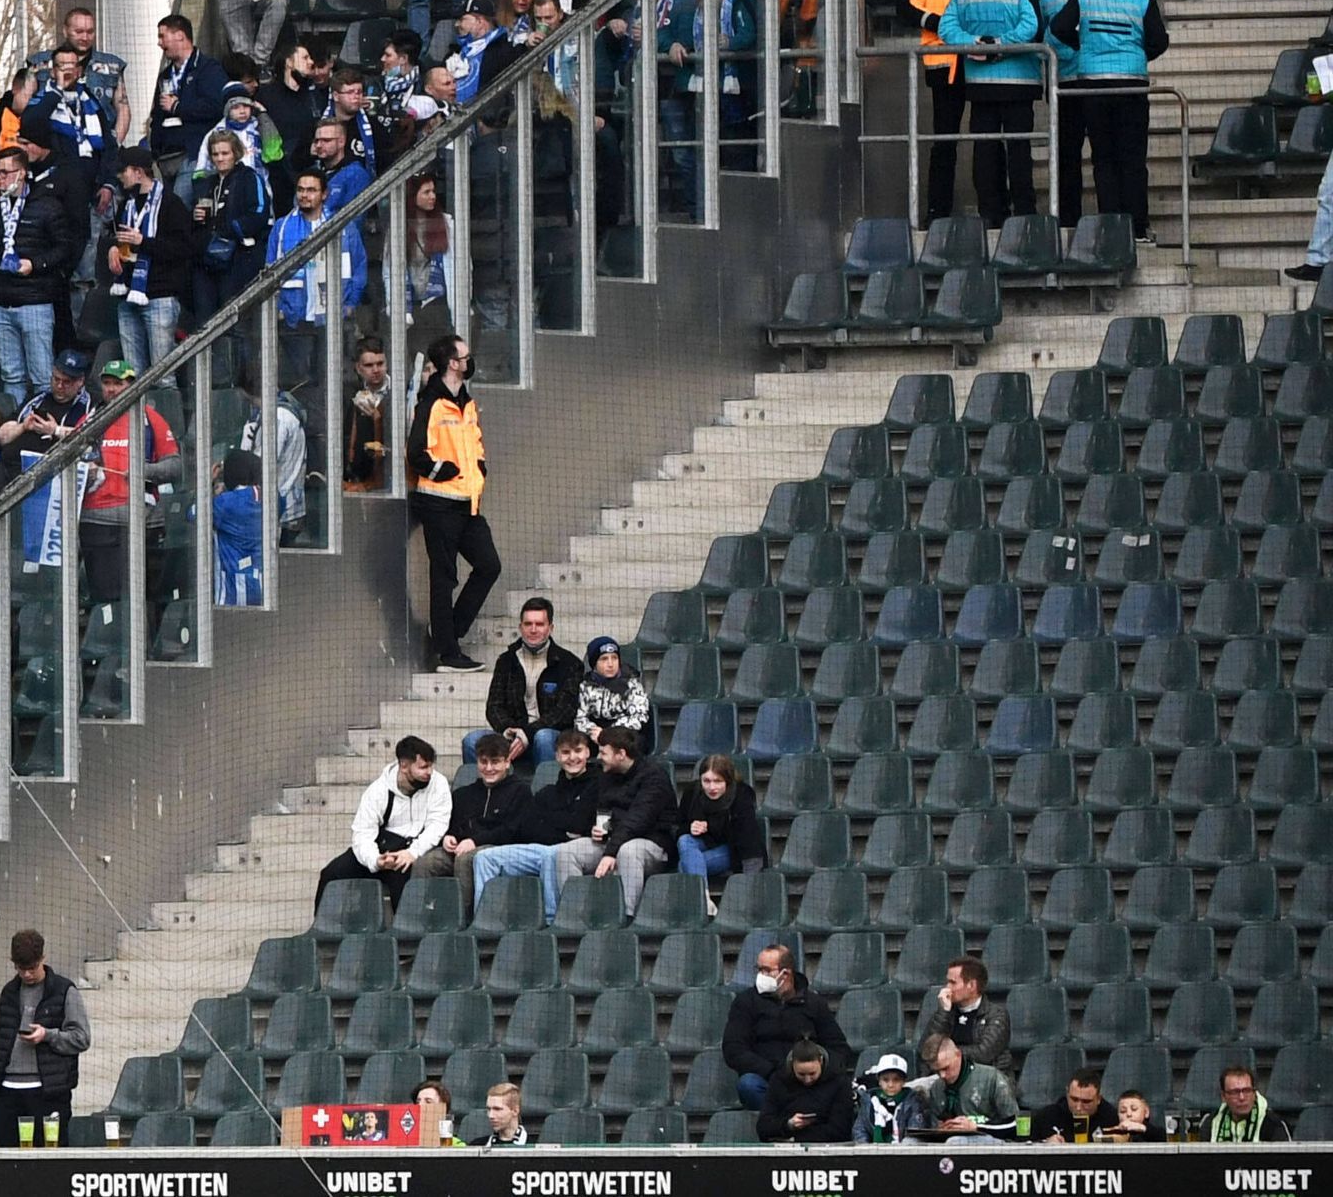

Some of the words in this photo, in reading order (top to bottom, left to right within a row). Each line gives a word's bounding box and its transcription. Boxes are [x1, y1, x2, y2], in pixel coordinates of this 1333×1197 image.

[71, 1173, 228, 1197] SPORTWETTEN
[326, 1172, 411, 1193] UNIBET
[512, 1171, 672, 1195] SPORTWETTEN
[772, 1170, 858, 1191] UNIBET
[959, 1169, 1123, 1194] SPORTWETTEN
[1225, 1168, 1311, 1190] UNIBET
